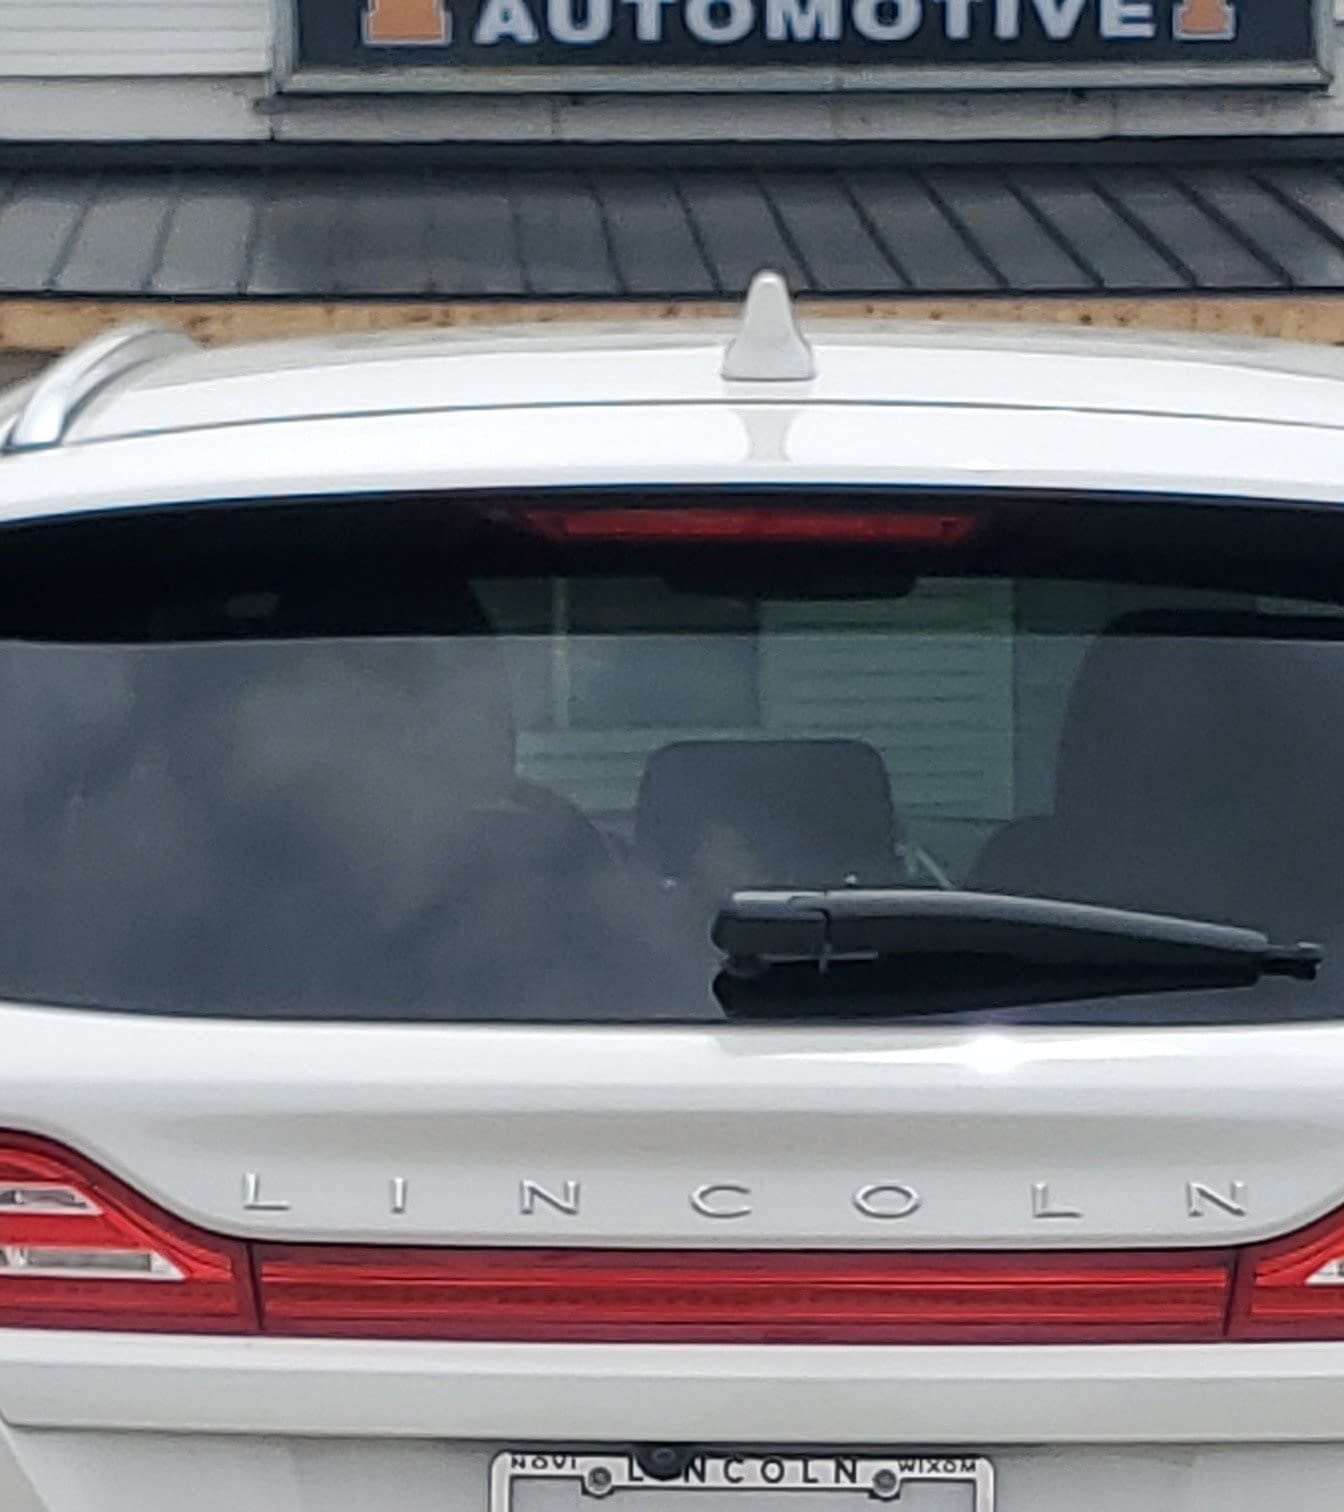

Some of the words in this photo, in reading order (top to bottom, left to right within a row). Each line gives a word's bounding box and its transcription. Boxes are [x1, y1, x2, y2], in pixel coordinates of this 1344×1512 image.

[476, 0, 1157, 42] AUTOMOTIVE
[242, 1174, 1246, 1218] LINCOLN
[509, 1456, 577, 1470] NOVI
[628, 1457, 858, 1484] LNCOLN
[898, 1458, 977, 1473] WIXOM
